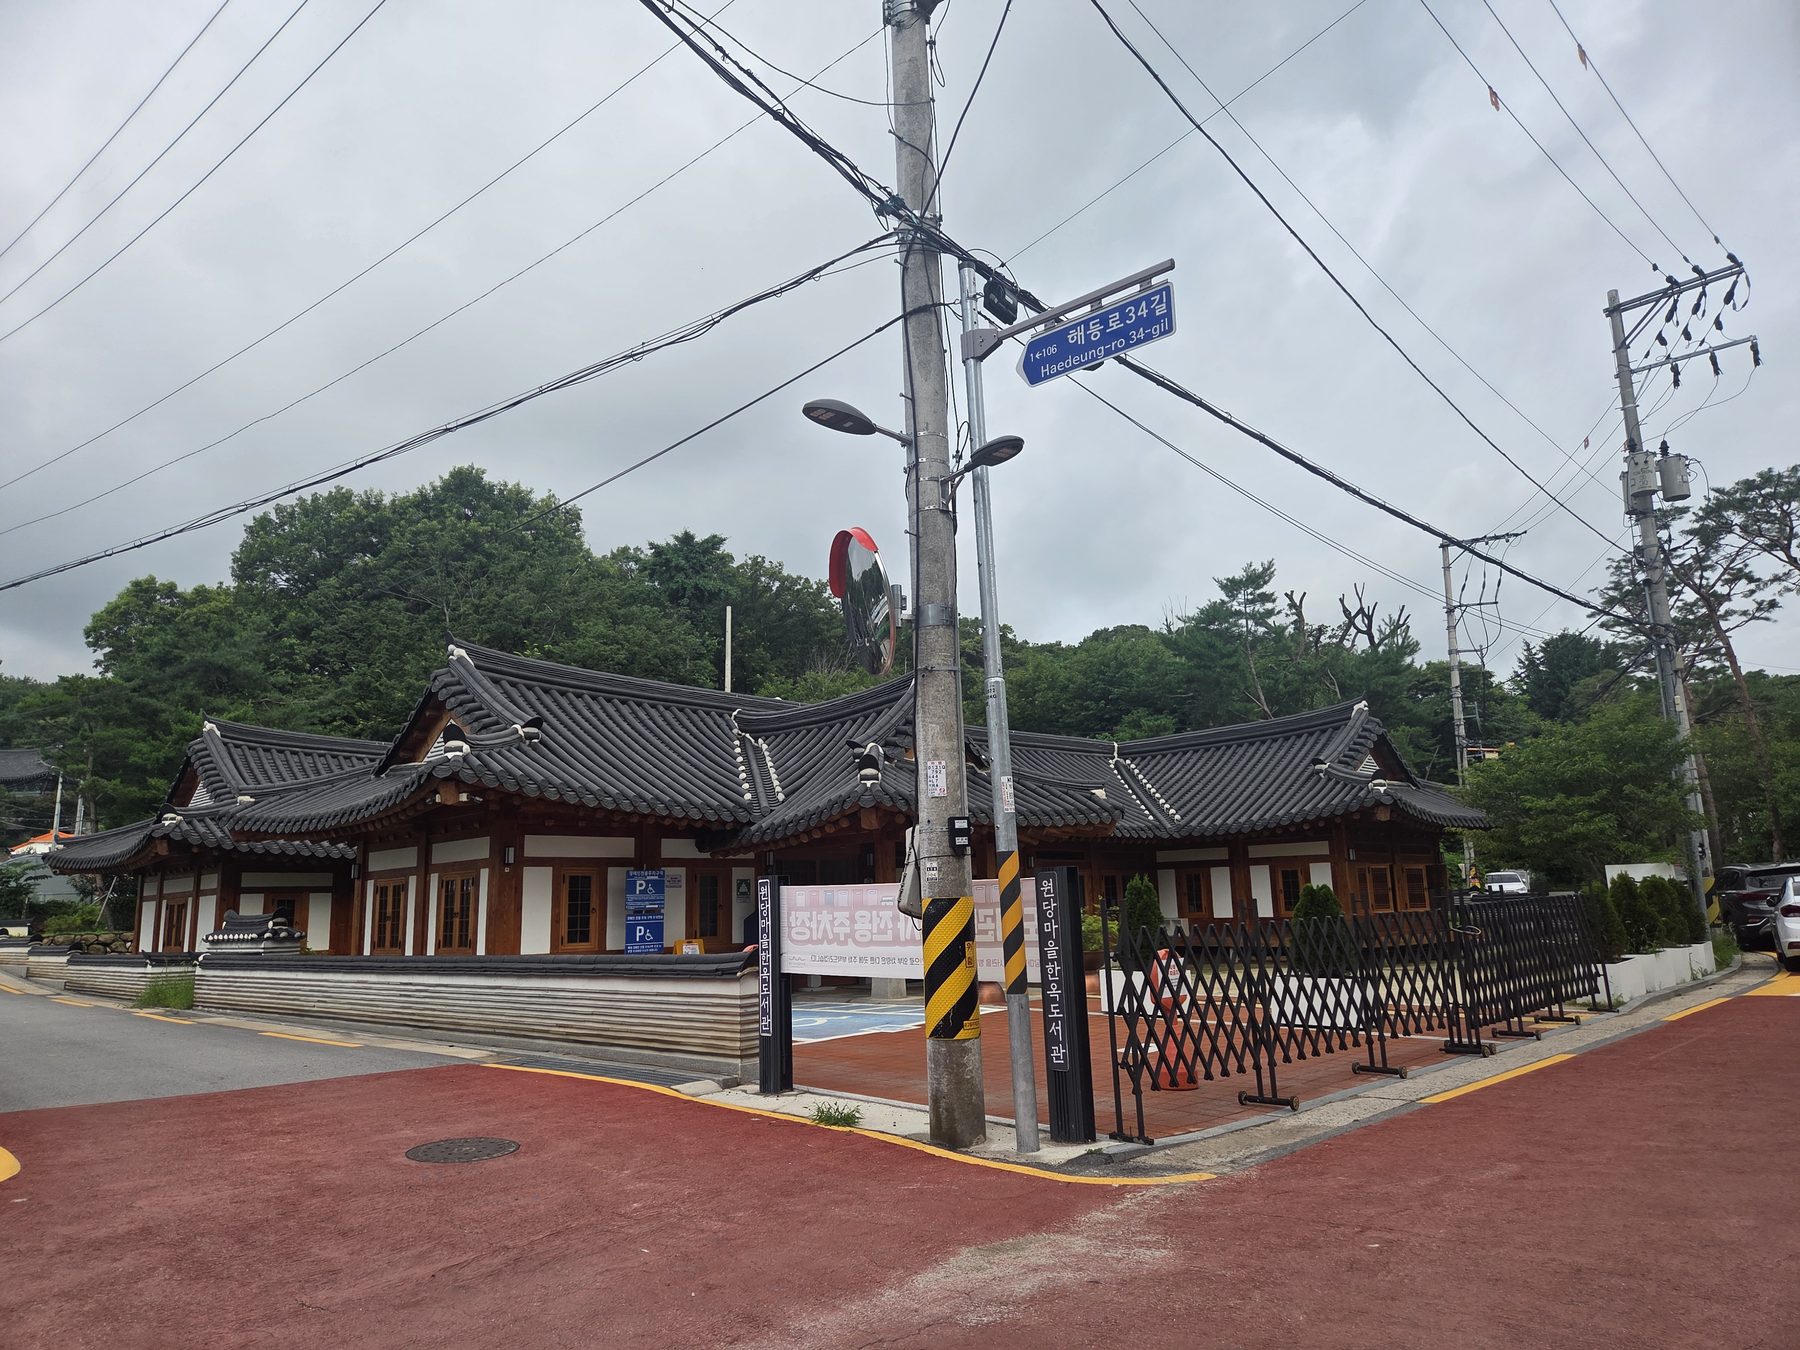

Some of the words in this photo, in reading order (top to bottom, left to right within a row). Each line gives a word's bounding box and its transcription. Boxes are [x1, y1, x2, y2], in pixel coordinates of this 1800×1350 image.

[1067, 290, 1168, 345] 해등로34길
[1041, 337, 1126, 378] Haedeung-ro
[1129, 317, 1169, 345] 34-gil
[635, 880, 646, 895] P
[636, 926, 645, 942] P
